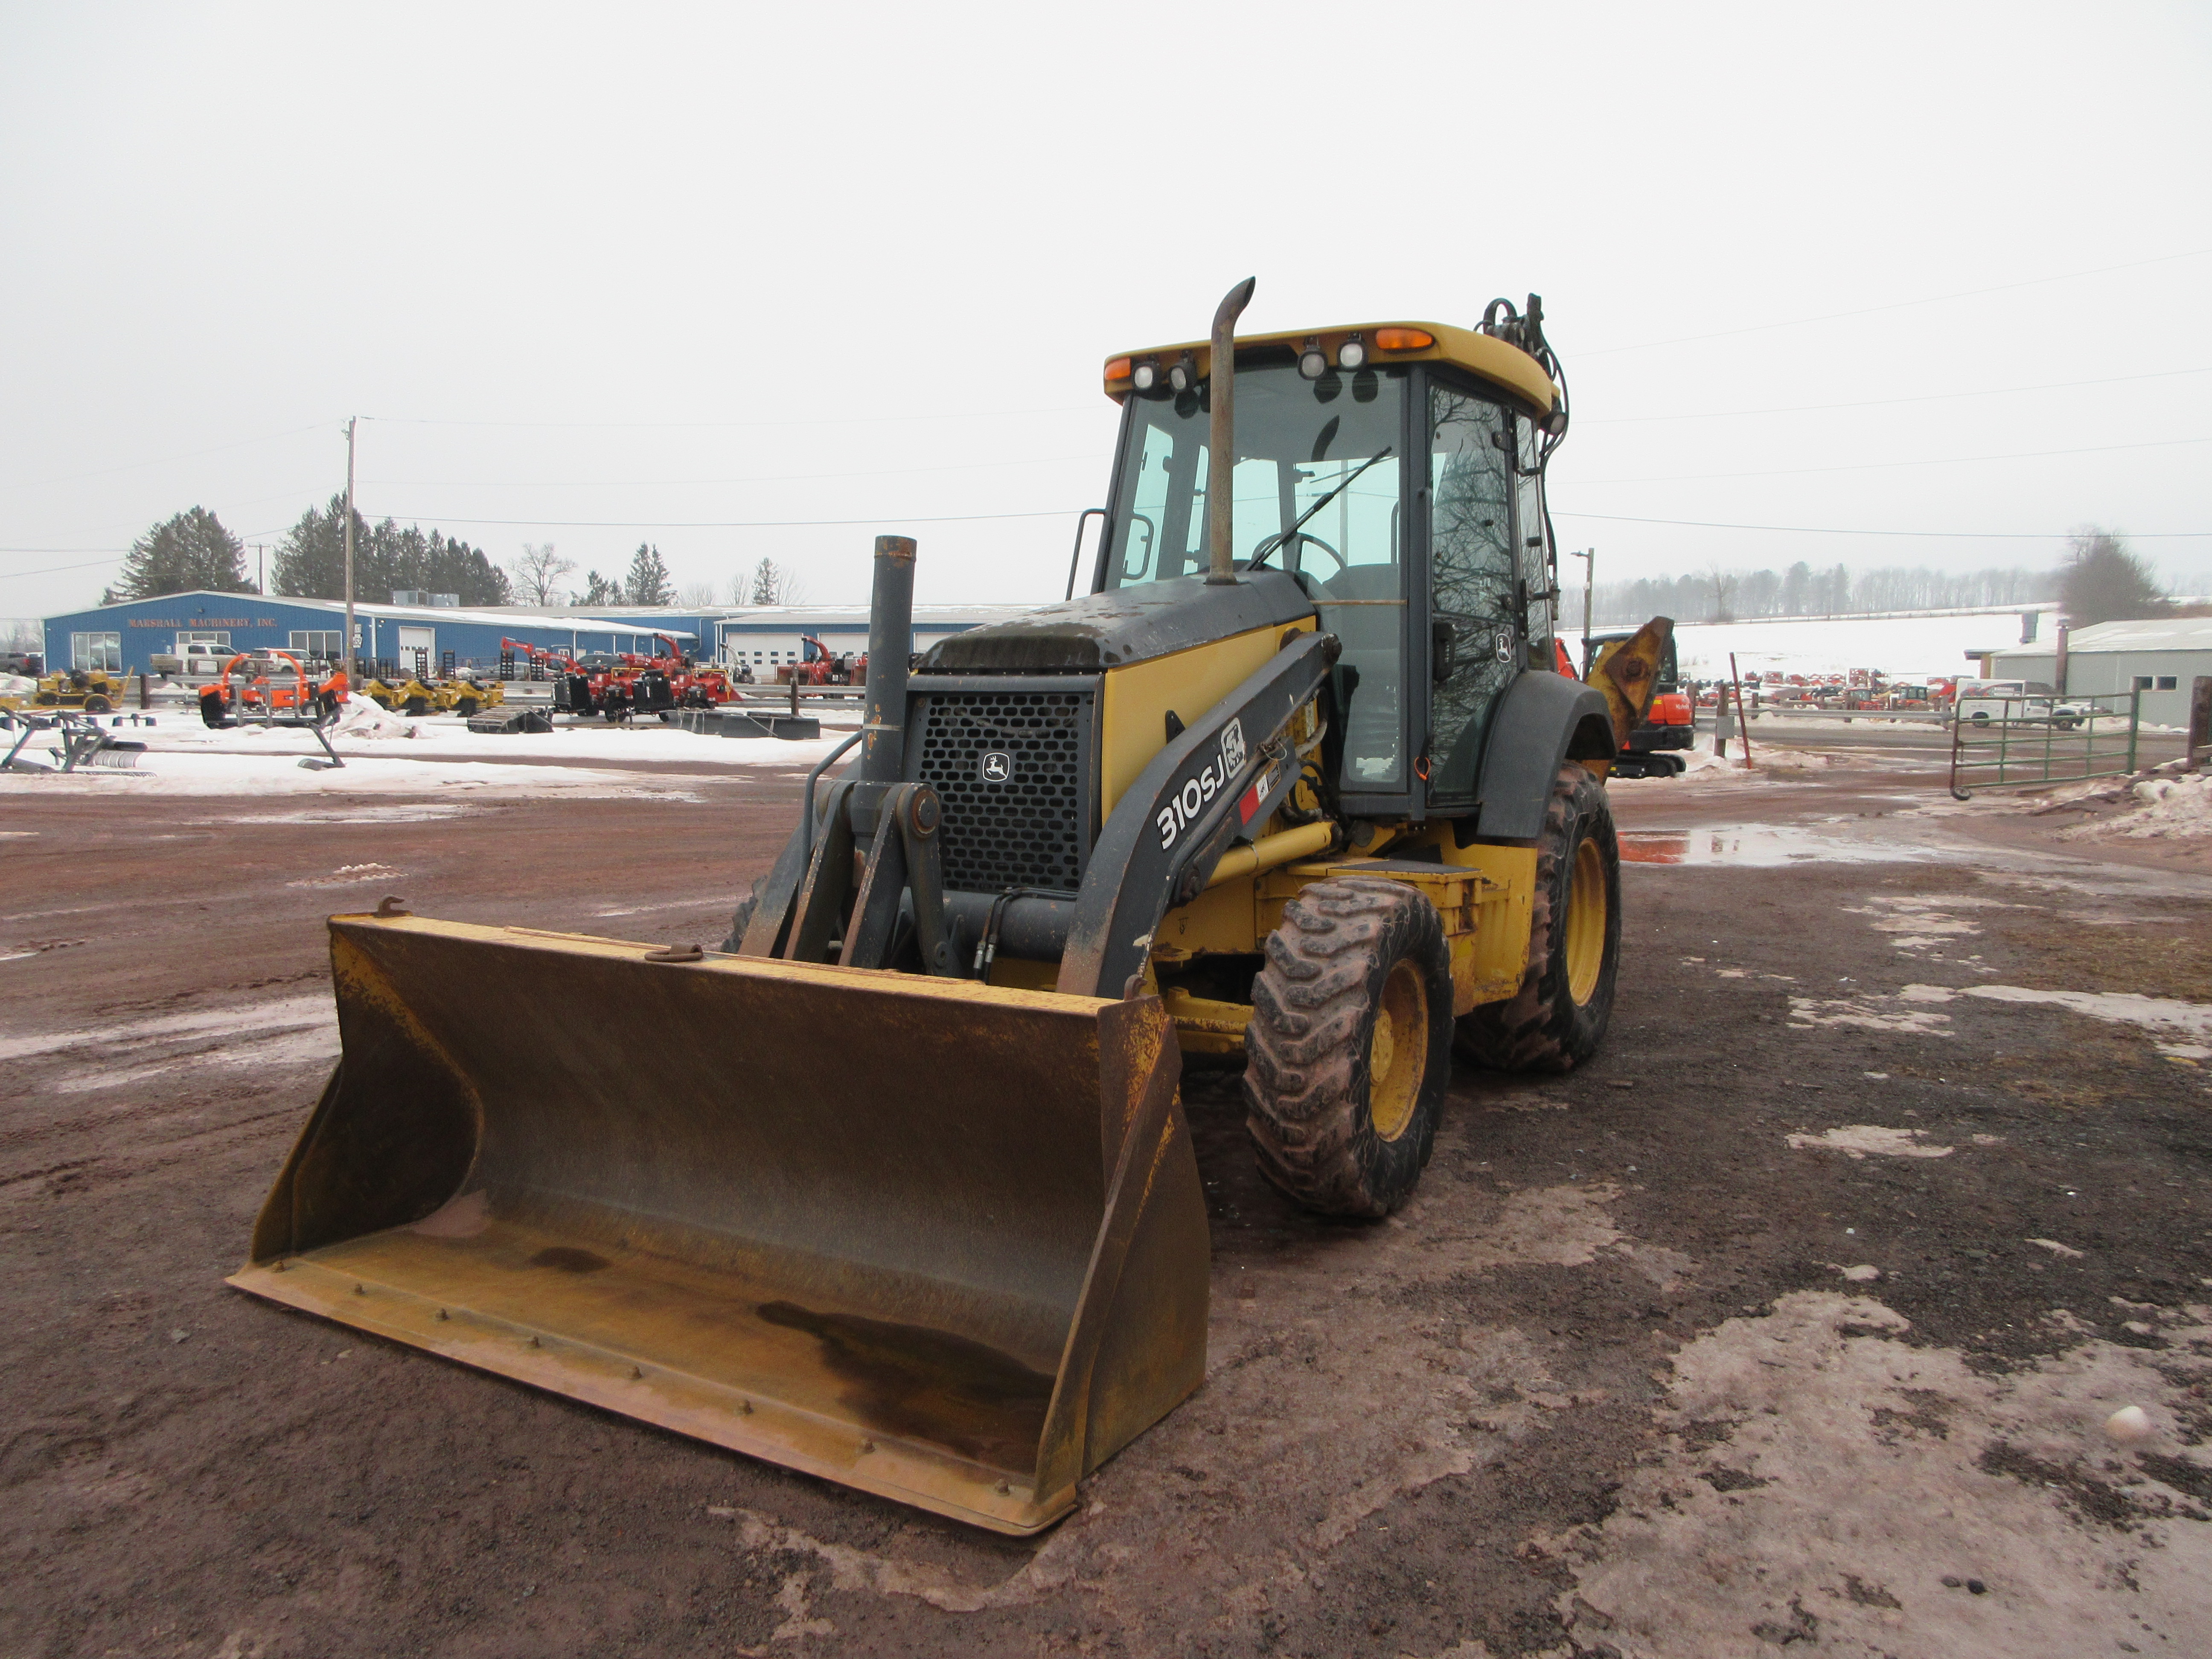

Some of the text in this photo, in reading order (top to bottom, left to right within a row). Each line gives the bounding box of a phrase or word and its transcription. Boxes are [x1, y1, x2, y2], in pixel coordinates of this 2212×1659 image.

[129, 619, 183, 627] MARSHALL
[258, 618, 278, 627] INC.
[1157, 754, 1225, 850] 310SJ
